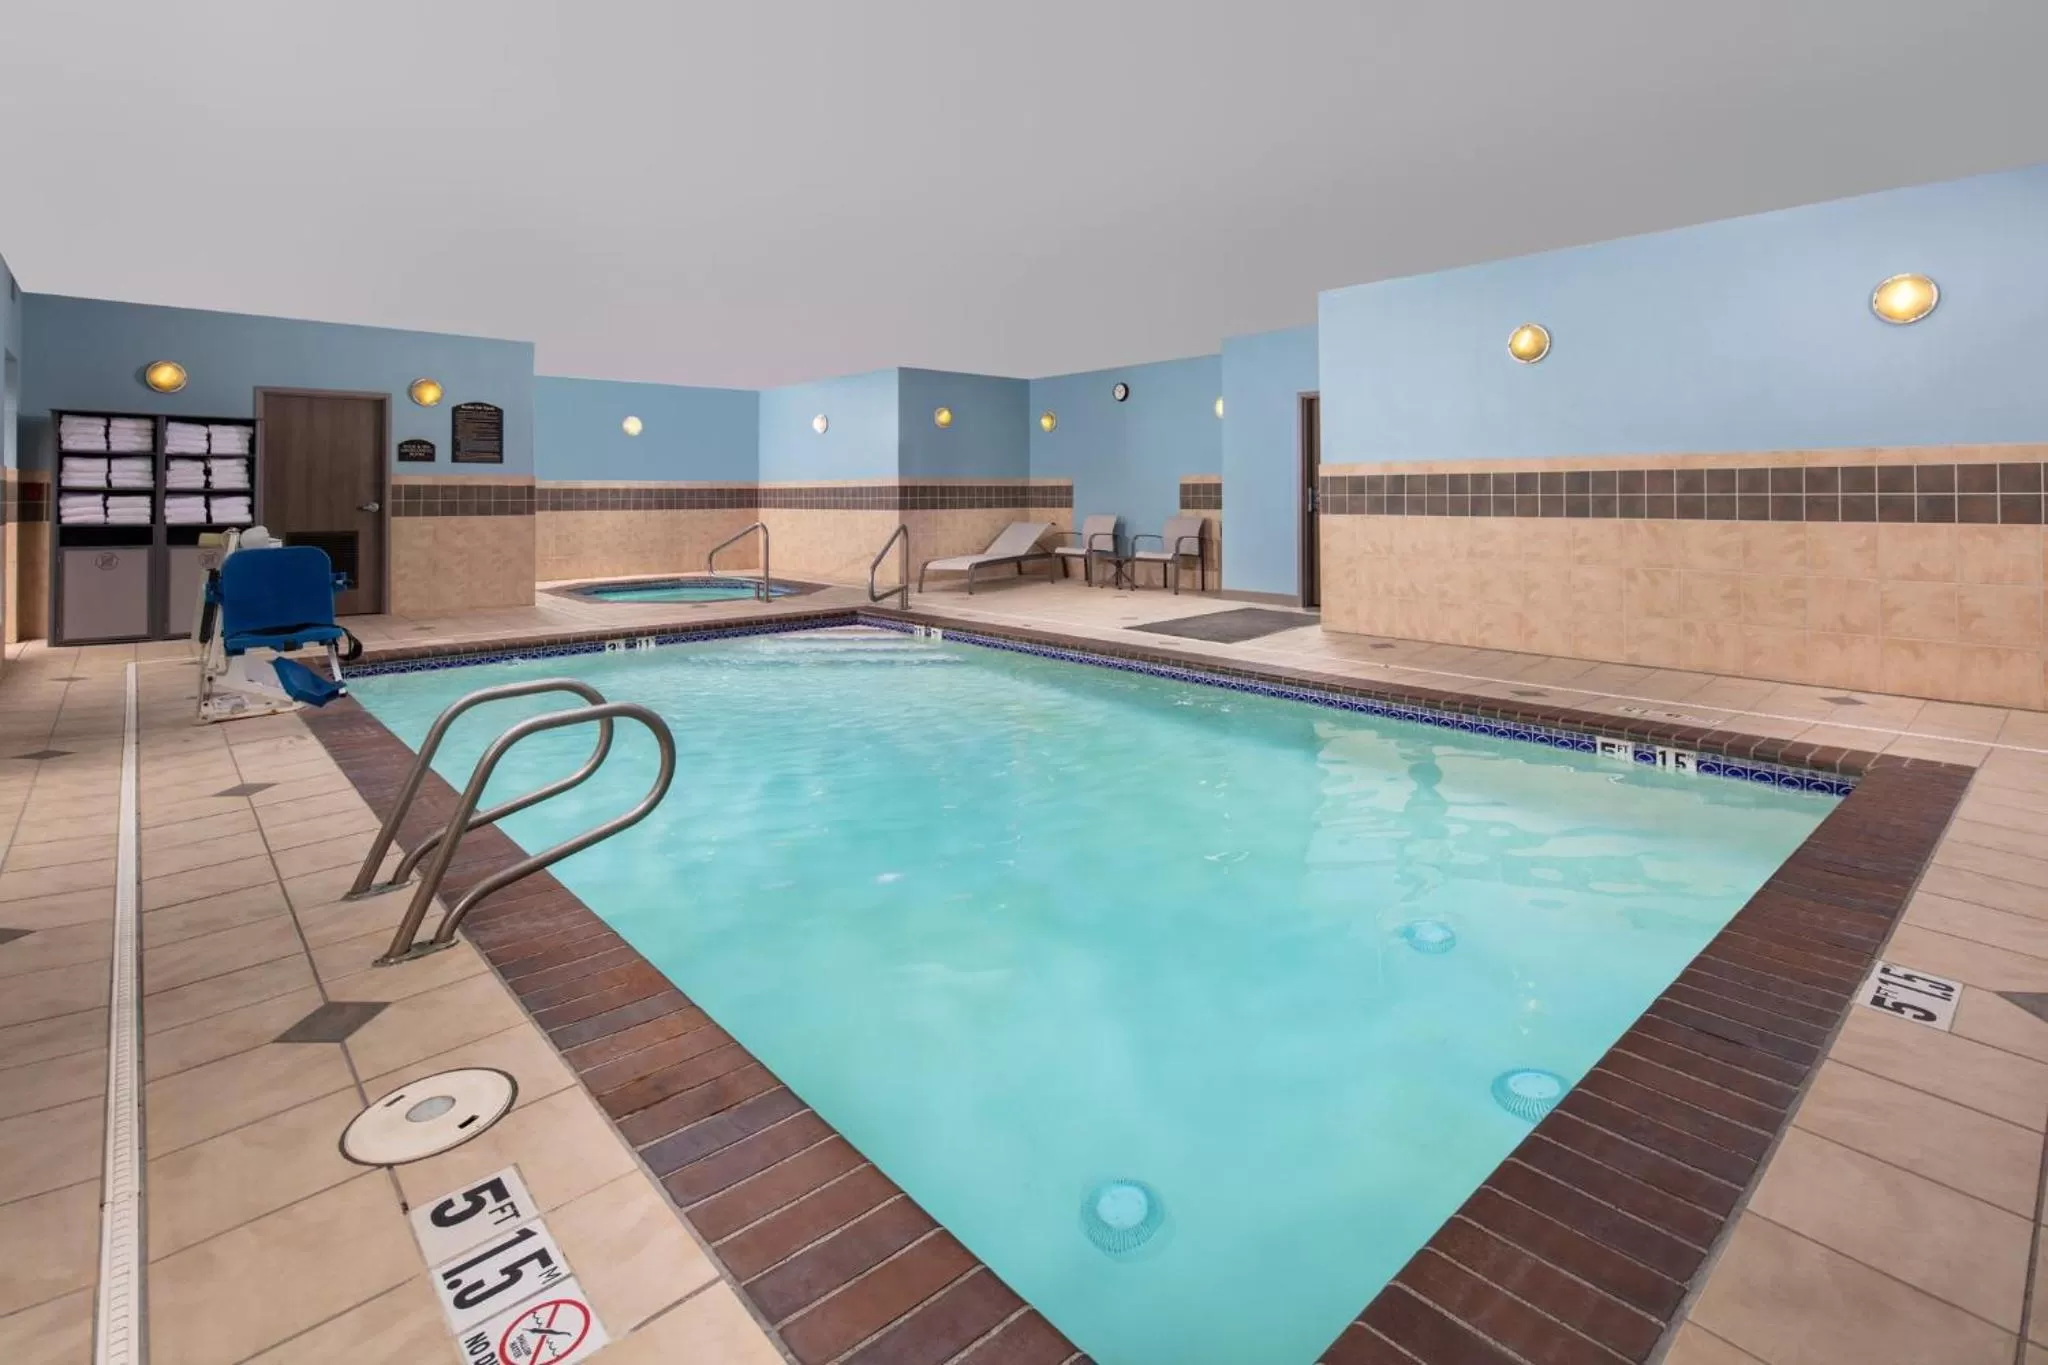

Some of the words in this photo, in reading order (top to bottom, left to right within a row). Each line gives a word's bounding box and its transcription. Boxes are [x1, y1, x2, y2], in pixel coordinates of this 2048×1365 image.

[1878, 967, 1955, 1002] 1.5
[1870, 995, 1937, 1022] 5
[430, 1176, 511, 1228] 5
[488, 1201, 521, 1226] FT
[441, 1227, 554, 1310] 1.5
[538, 1266, 562, 1285] M
[464, 1331, 491, 1356] NO
